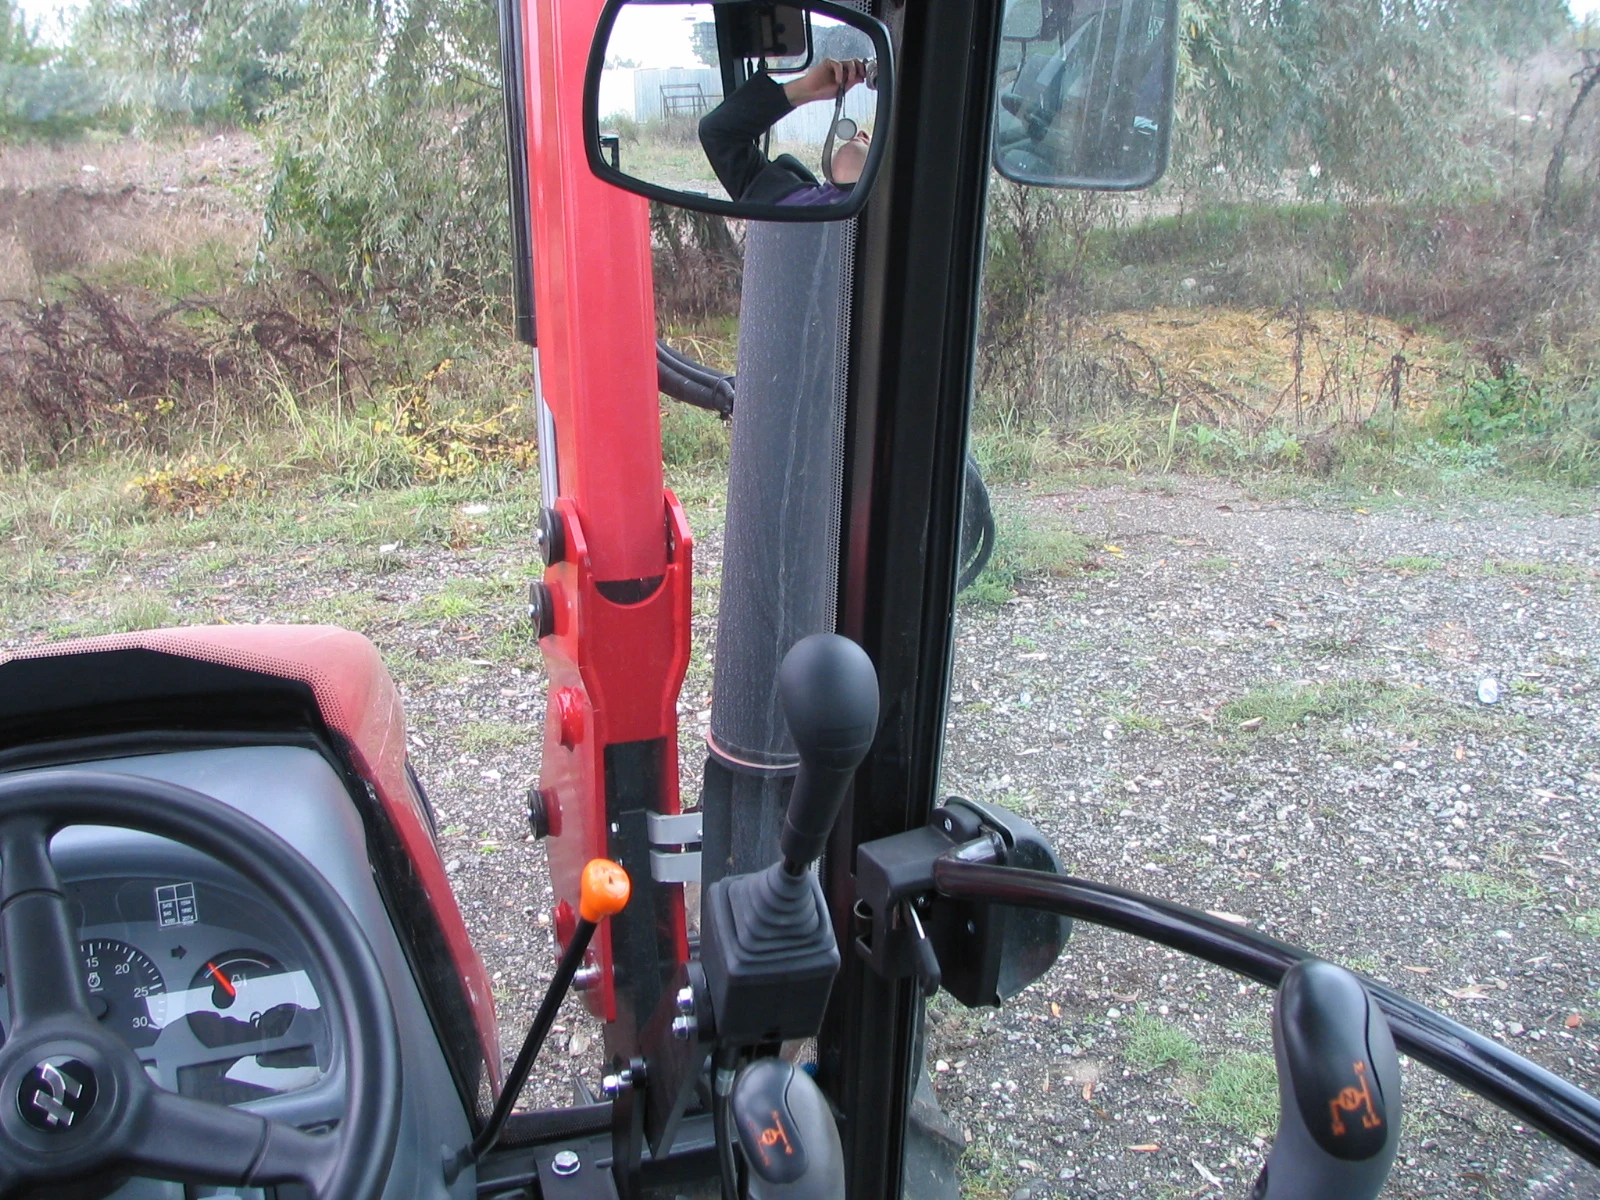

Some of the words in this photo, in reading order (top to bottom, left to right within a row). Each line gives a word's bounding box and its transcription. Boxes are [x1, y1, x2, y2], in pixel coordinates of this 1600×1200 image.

[86, 957, 99, 968] 15
[114, 963, 130, 975] 20
[133, 986, 149, 998] 25
[132, 1016, 148, 1028] 30
